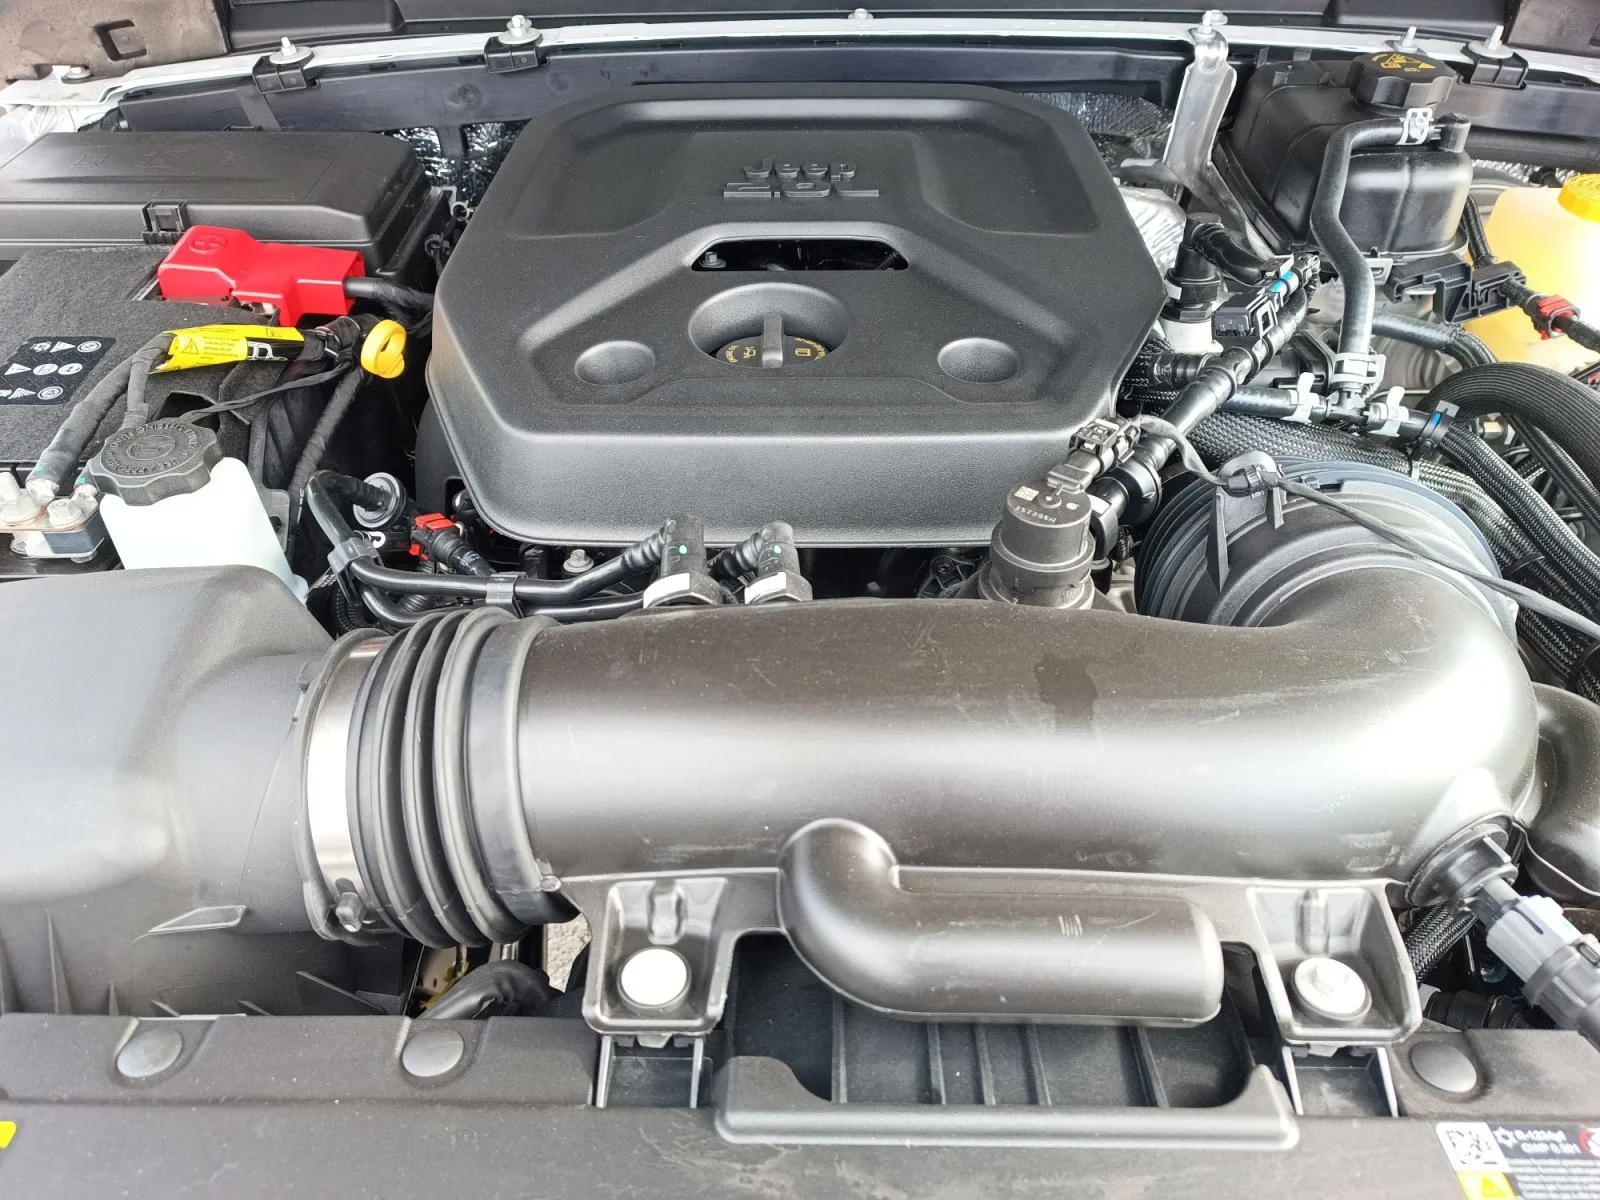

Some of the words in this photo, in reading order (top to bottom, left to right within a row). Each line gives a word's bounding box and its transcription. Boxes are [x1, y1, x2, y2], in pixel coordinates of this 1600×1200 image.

[743, 159, 856, 181] Jeep
[723, 182, 880, 198] 2.0L
[105, 457, 154, 475] APPROVED
